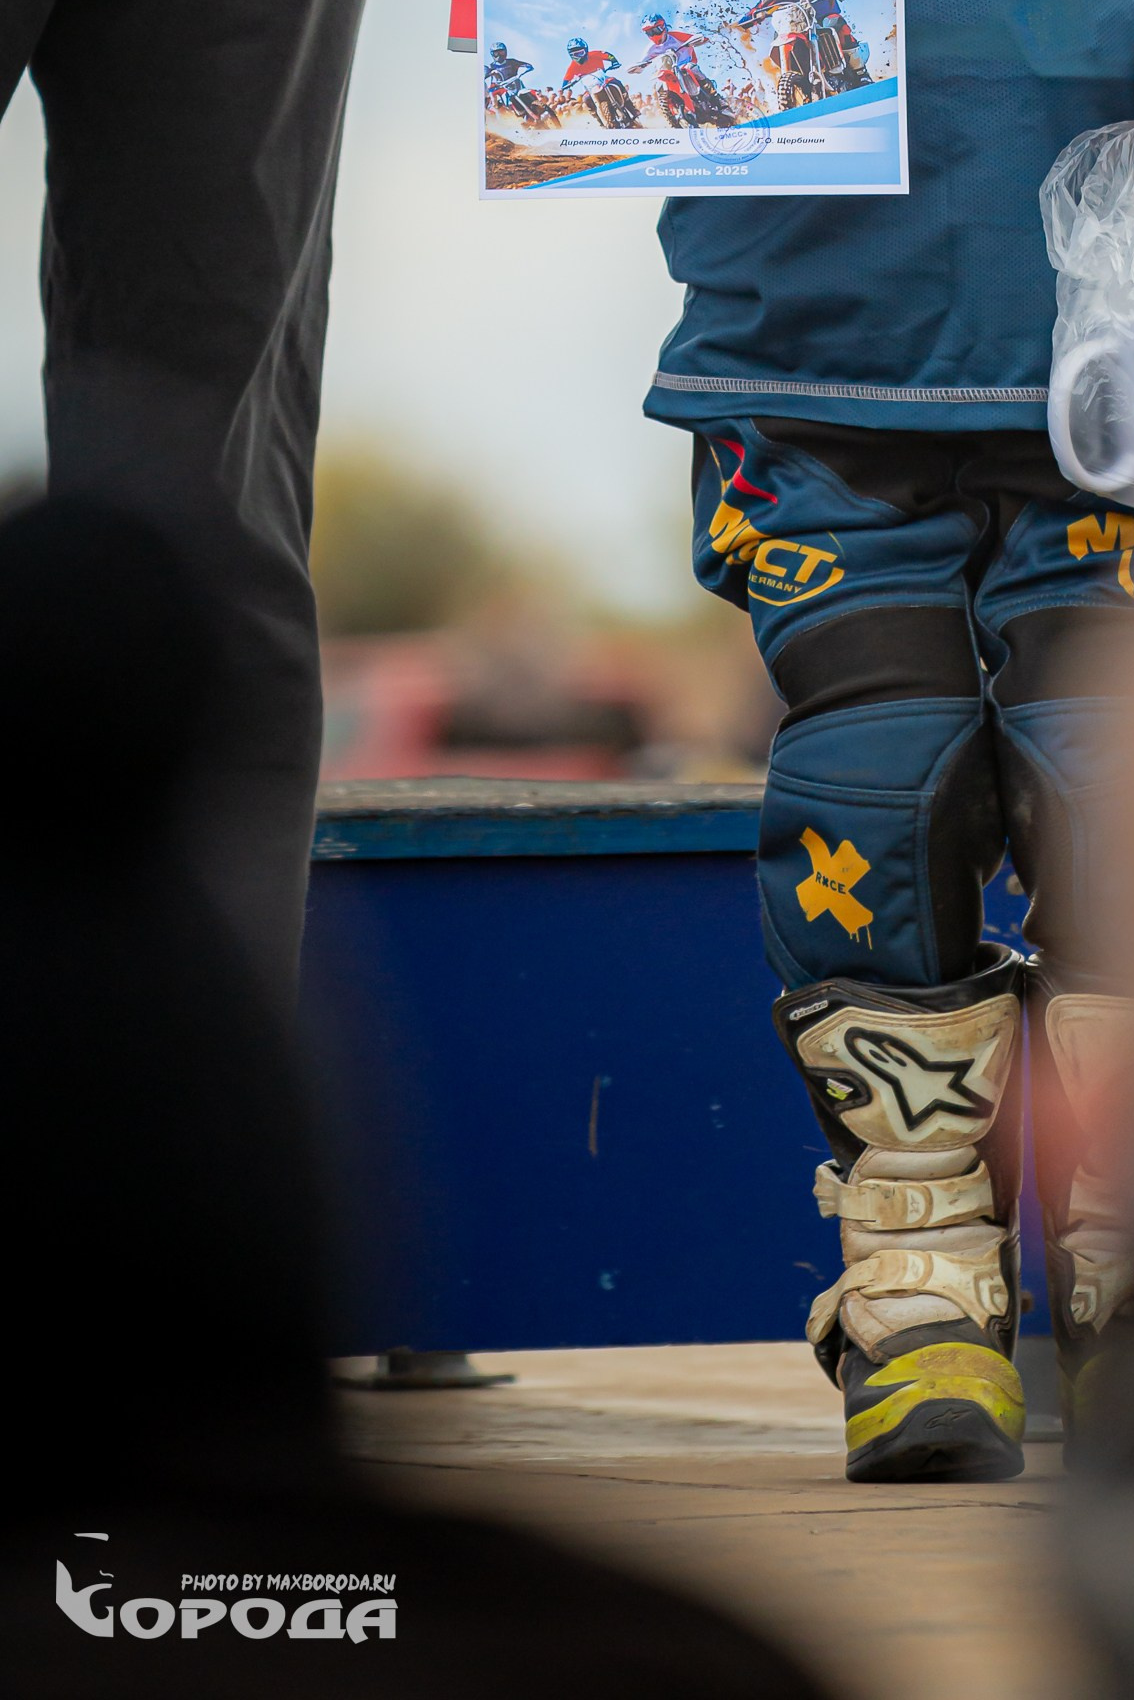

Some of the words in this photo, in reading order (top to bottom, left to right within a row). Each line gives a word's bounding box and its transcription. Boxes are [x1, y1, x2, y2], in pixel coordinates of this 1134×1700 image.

[560, 138, 608, 148] Директор
[610, 138, 640, 146] МОСО
[777, 137, 825, 146] Щербинин
[645, 166, 711, 179] Сызрань
[715, 165, 749, 177] 2025
[748, 574, 803, 595] ERMANY
